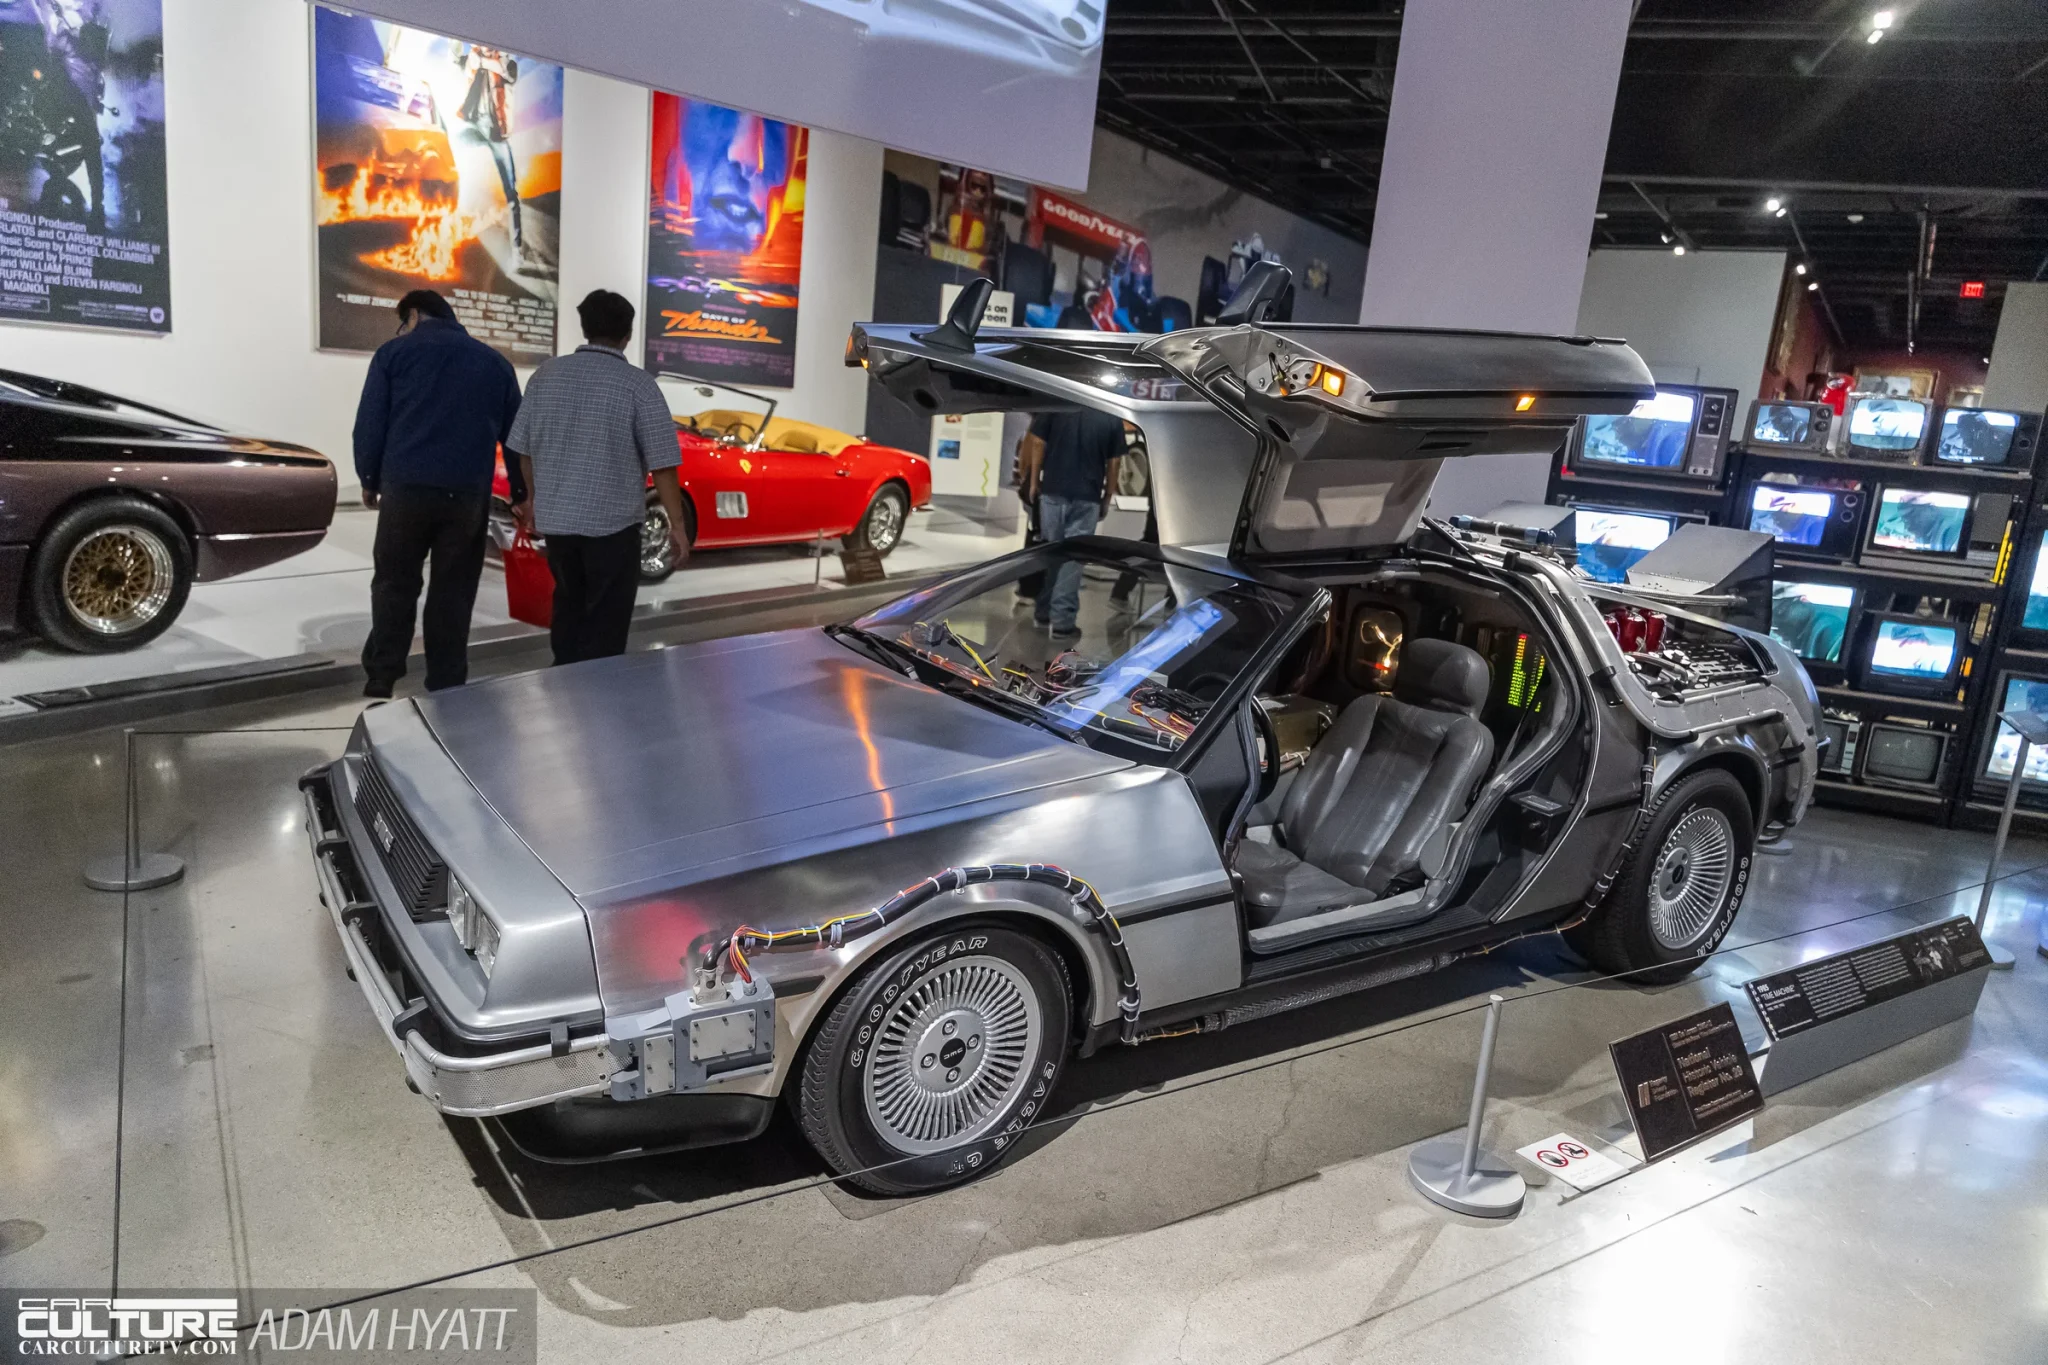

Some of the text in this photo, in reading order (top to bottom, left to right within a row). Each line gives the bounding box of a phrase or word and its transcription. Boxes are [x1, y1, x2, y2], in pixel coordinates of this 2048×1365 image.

[38, 215, 87, 232] Production
[24, 237, 51, 250] Score
[52, 241, 64, 255] by
[65, 242, 101, 258] MICHEL
[56, 230, 104, 247] CLARENCE
[105, 238, 151, 254] WILLIAMS
[20, 259, 62, 274] WILLIAM
[46, 251, 58, 265] by
[59, 253, 93, 267] PRINCE
[3, 280, 50, 295] MAGNOLI
[43, 275, 60, 285] and
[62, 275, 98, 290] STEVEN
[99, 279, 143, 294] FARGNOLI
[1964, 282, 1982, 296] EXIT
[1697, 856, 1749, 956] GOODYEAR
[851, 936, 989, 1067] GOODYEAR
[1677, 1047, 1712, 1069] National
[1682, 1053, 1738, 1083] Historic Vehicle
[993, 1061, 1056, 1150] EAGLE
